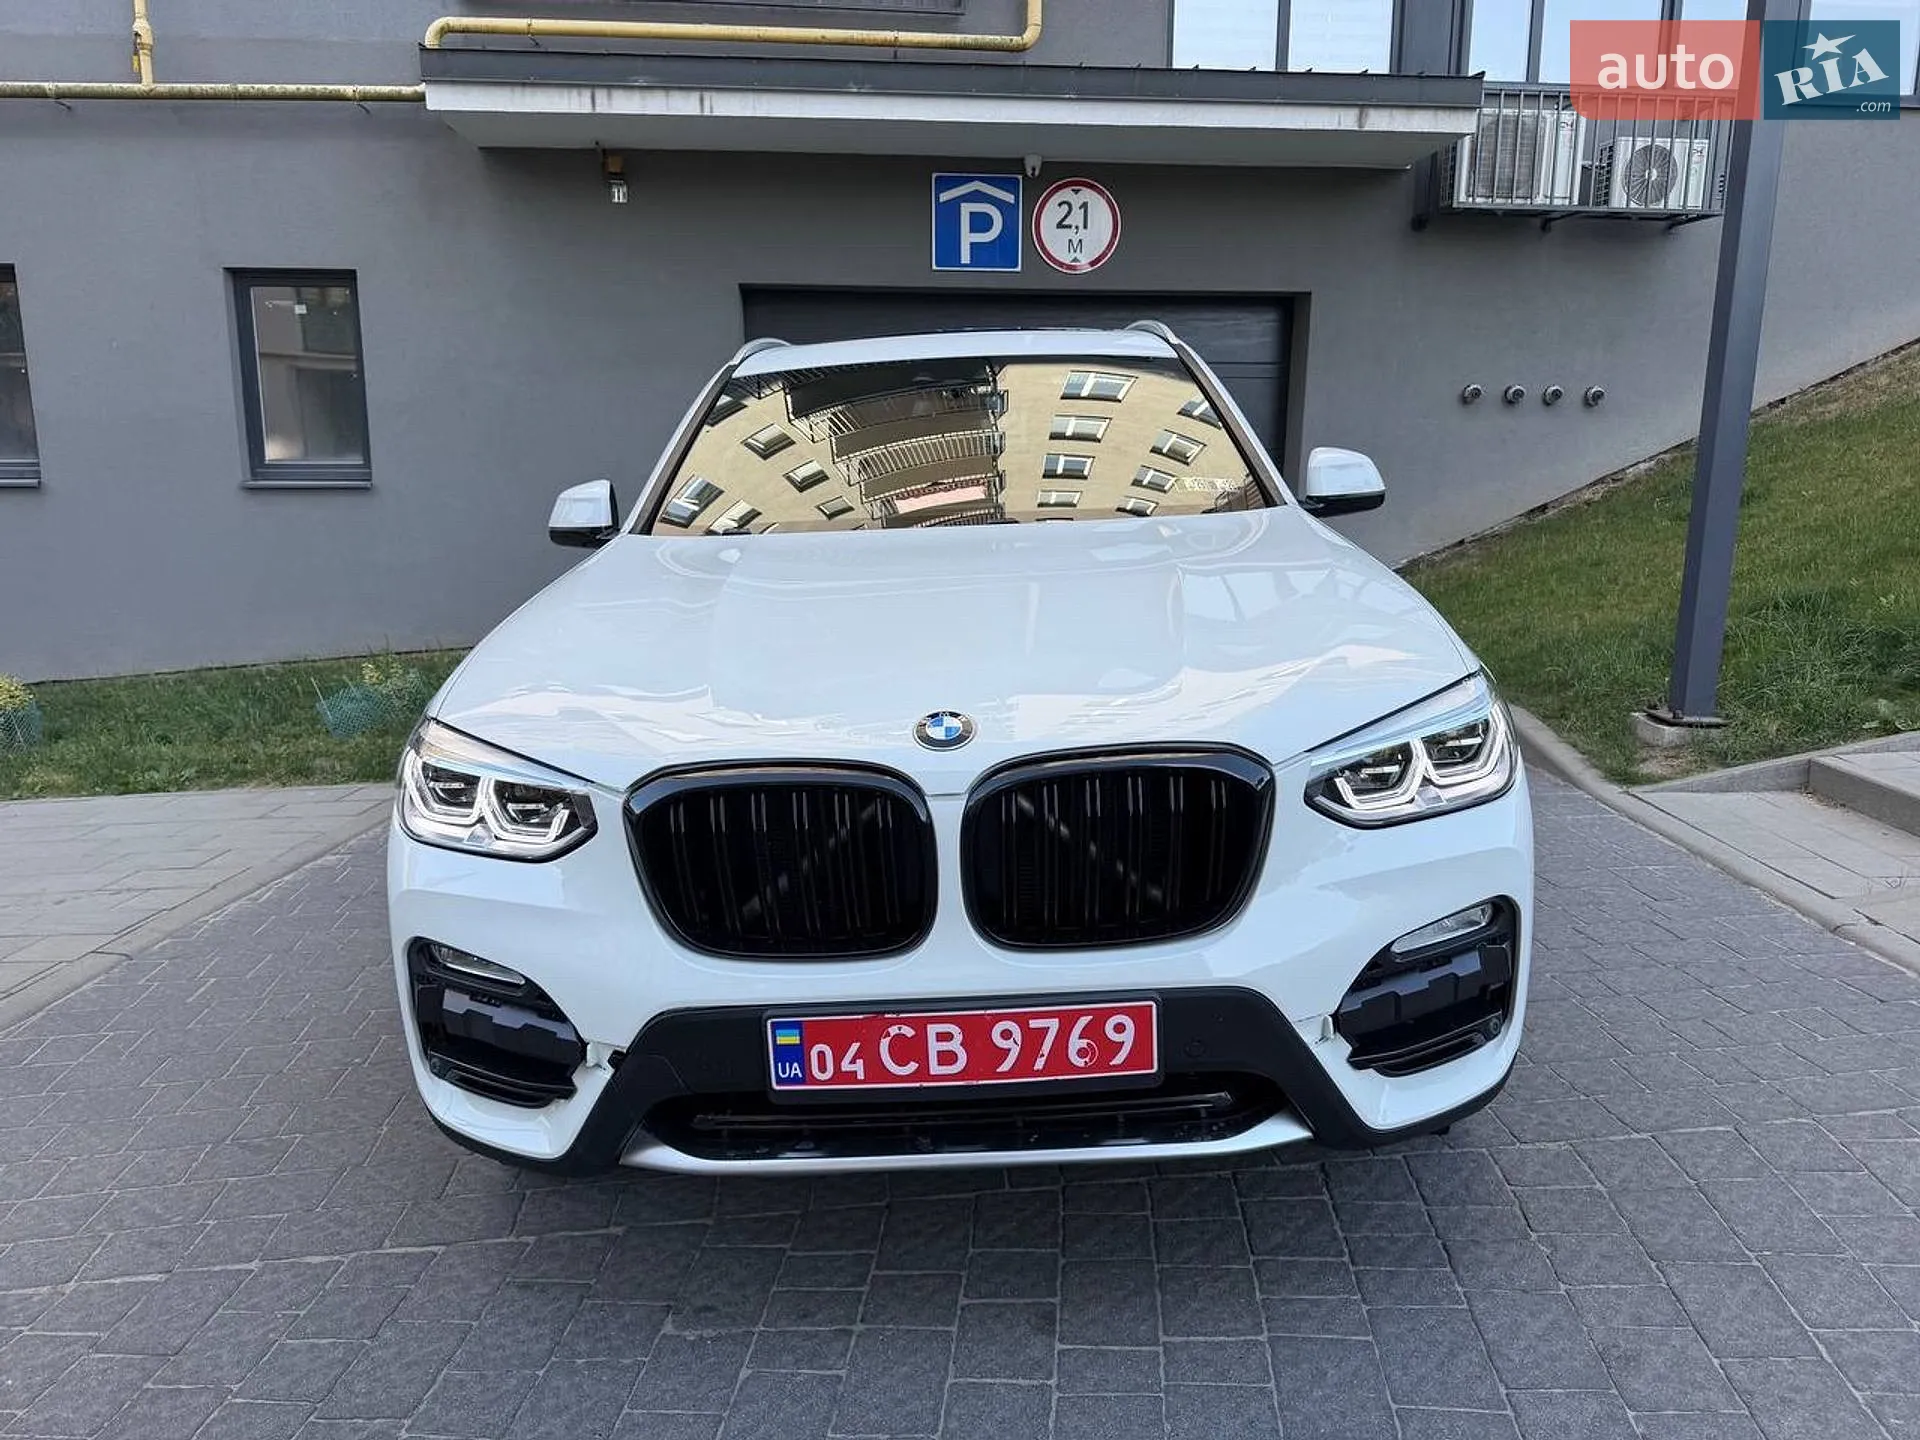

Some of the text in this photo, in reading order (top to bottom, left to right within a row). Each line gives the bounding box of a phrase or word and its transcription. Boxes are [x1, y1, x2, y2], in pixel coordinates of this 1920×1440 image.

[960, 202, 1004, 264] P
[1055, 200, 1089, 235] 2,1
[777, 1061, 803, 1079] UA
[810, 1014, 1136, 1081] 04 CB 9769
